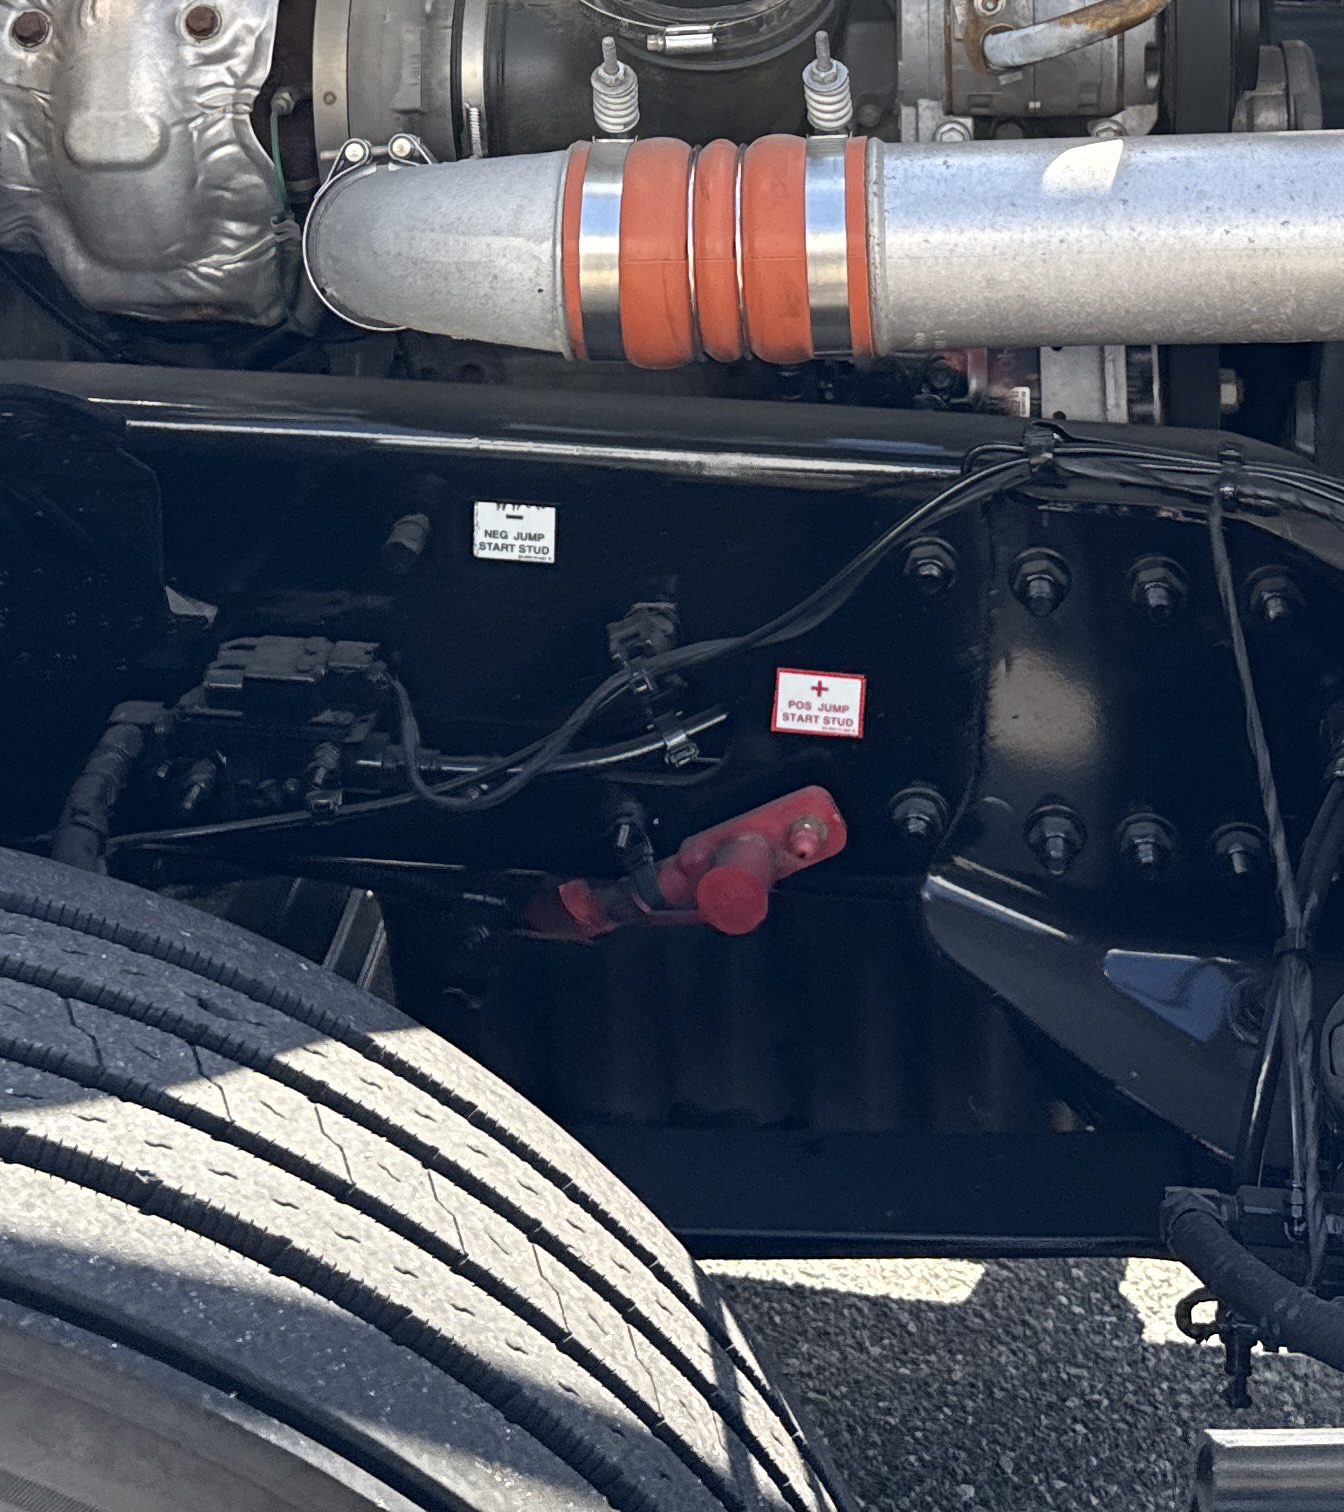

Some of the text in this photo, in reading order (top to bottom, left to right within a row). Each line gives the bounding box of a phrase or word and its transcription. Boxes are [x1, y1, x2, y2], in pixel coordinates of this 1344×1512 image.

[484, 529, 545, 541] NEG JUMP
[478, 541, 550, 555] START STUD
[787, 699, 850, 713] POS JUMP
[782, 712, 854, 727] START STUD
